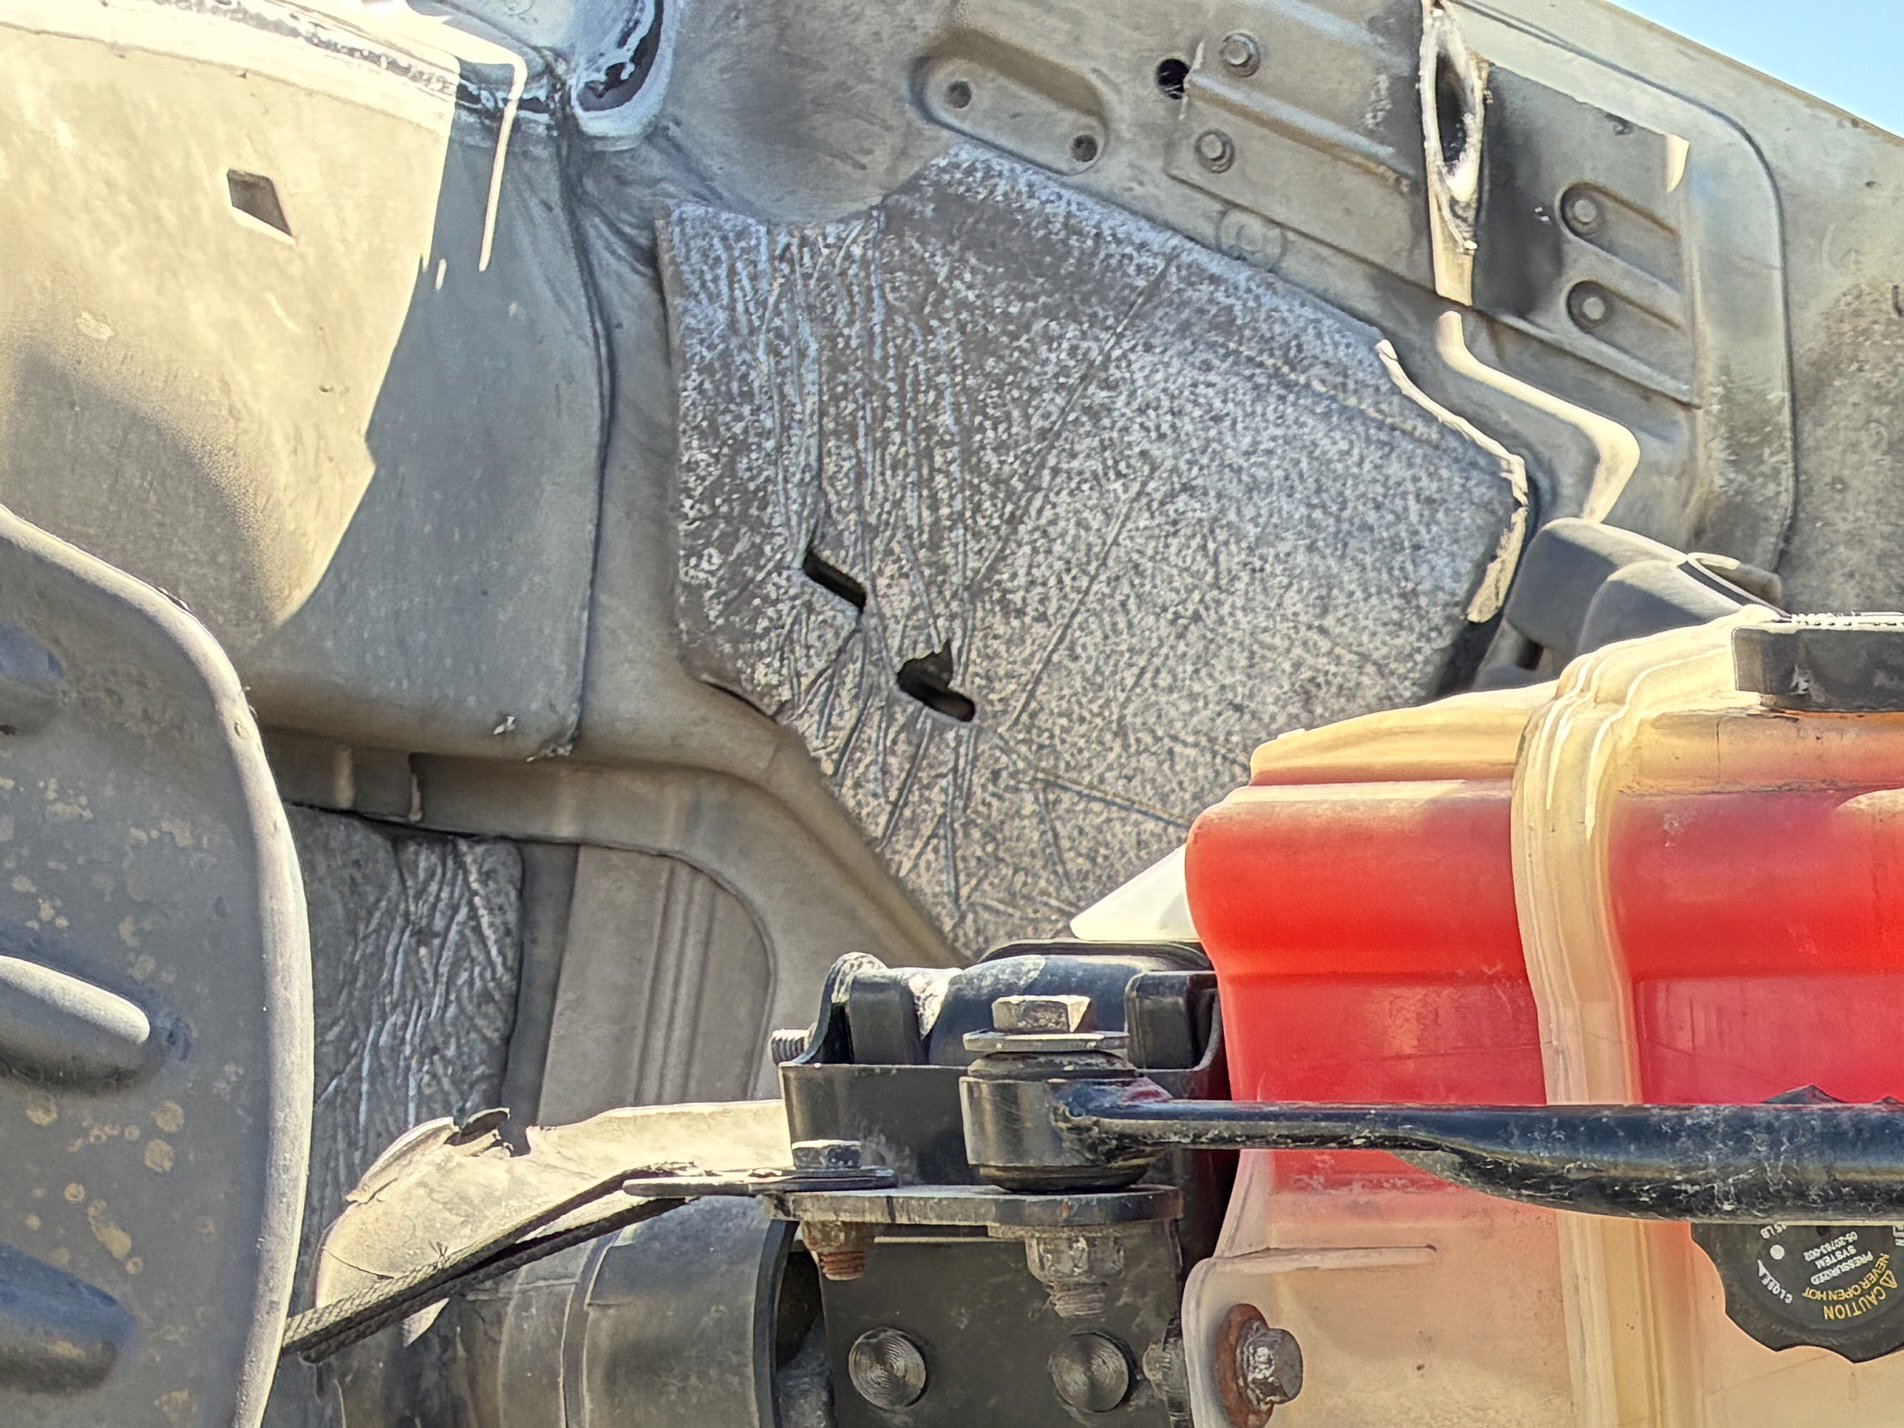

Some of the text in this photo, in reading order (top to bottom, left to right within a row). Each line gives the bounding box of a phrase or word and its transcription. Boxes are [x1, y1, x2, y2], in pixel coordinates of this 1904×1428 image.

[1811, 1251, 1874, 1285] PRESSURIZED
[1815, 1245, 1856, 1269] SYSTEM
[1802, 1253, 1890, 1301] NEVER OPEN HOT
[1823, 1286, 1886, 1320] CAUTION
